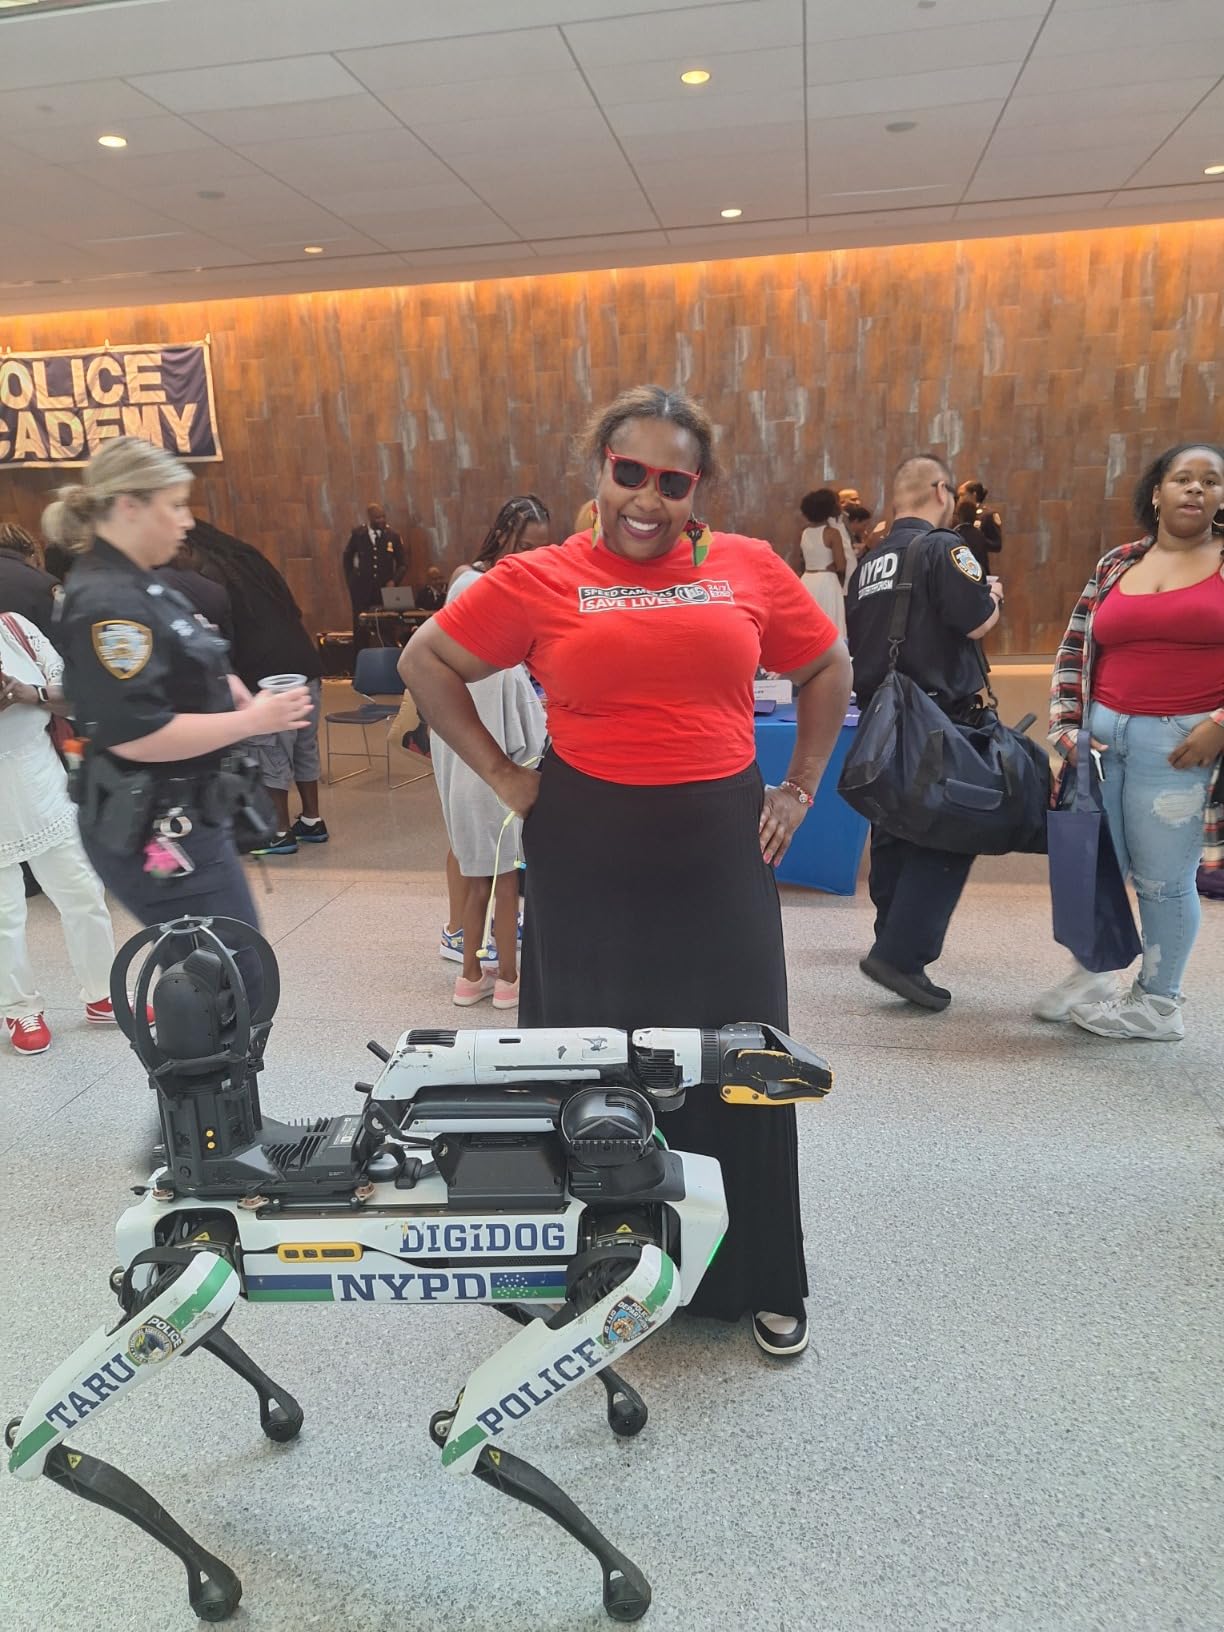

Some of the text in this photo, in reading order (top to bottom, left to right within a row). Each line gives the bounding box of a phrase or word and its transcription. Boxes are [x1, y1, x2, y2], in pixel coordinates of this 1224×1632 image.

[859, 553, 898, 589] NYPD
[583, 588, 618, 597] SPEED
[585, 597, 677, 610] SAVE LIVES
[400, 1223, 565, 1253] DIGIDOG
[337, 1273, 487, 1302] NYPD
[147, 1317, 182, 1349] POLICE
[45, 1352, 136, 1430] TARU
[476, 1337, 603, 1436] POLICE
